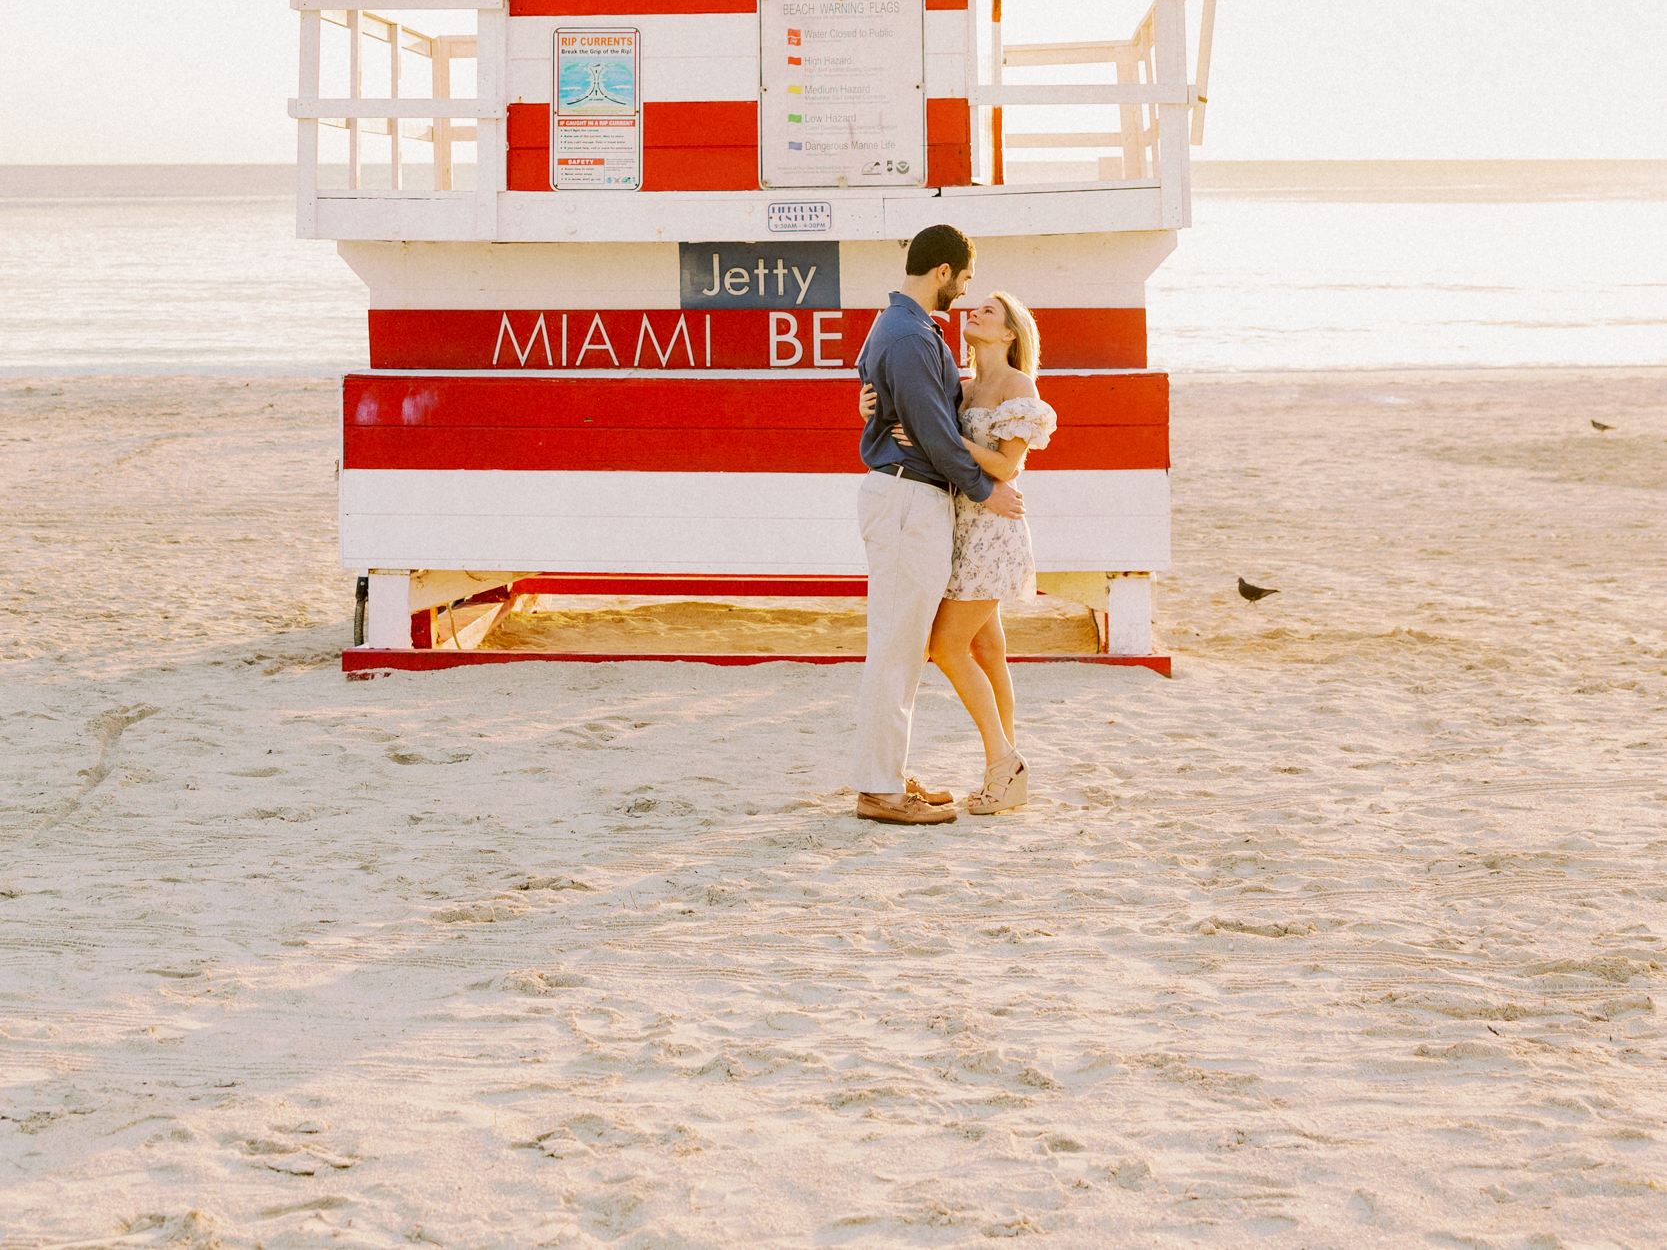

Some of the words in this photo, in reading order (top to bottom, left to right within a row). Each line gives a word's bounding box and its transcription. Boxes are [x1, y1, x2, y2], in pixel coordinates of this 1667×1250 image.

[783, 3, 815, 15] BEACH
[820, 2, 864, 14] WARNING
[869, 1, 900, 13] FLAGS
[804, 30, 827, 38] Water
[829, 29, 857, 38] Closed
[859, 29, 867, 38] to
[869, 28, 894, 37] Public
[561, 36, 577, 46] RIP
[580, 36, 633, 46] CURRENTS
[804, 56, 822, 67] High
[824, 56, 852, 65] Hazard
[804, 85, 837, 94] Medium
[840, 85, 871, 93] Hazard
[804, 114, 822, 123] Low
[825, 113, 857, 122] Hazard
[805, 141, 848, 152] Dangerous
[851, 141, 878, 150] Marine
[881, 140, 895, 149] Life
[702, 253, 817, 305] Jetty
[492, 311, 711, 367] MIAMI
